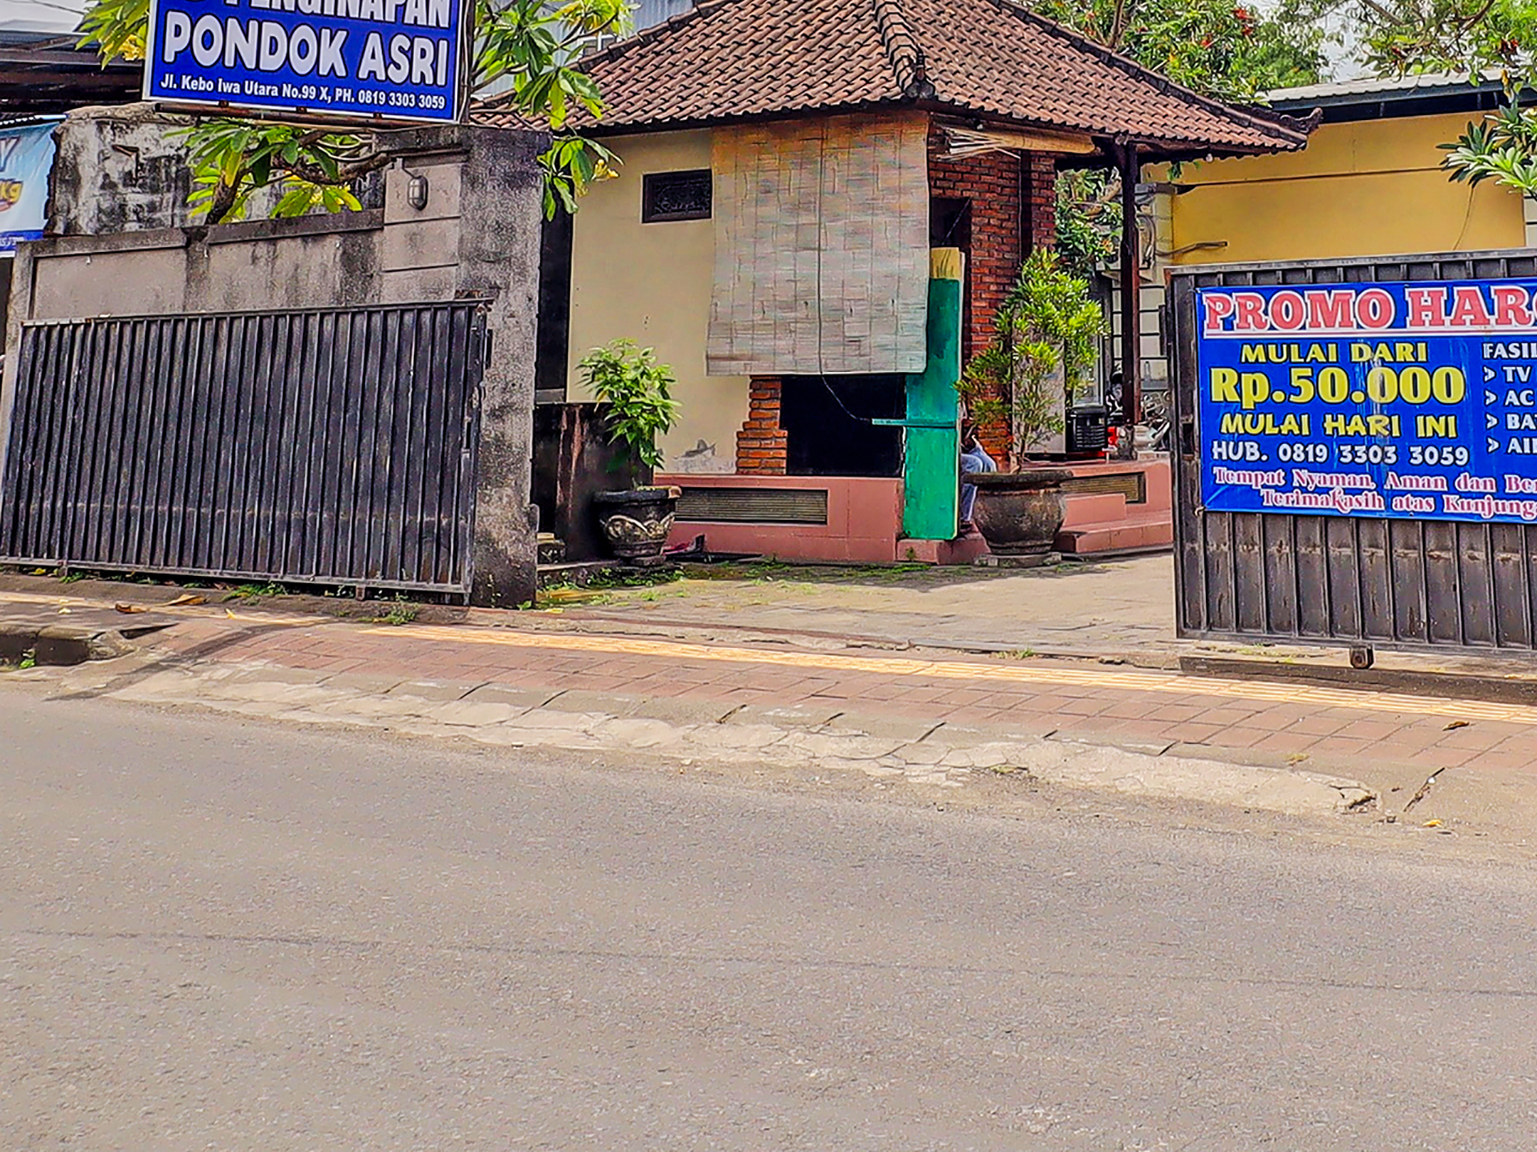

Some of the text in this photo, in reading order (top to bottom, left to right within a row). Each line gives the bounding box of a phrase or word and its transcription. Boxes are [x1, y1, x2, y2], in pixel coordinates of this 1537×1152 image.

[163, 11, 449, 87] PONDOK ASRI
[160, 73, 446, 110] Jl. Kebo Iwa Utara No.99 X, PH. 0819 3303 3059
[1202, 288, 1395, 331] PROMO
[1241, 342, 1428, 363] MULAI DARI
[1502, 365, 1531, 383] TV
[1210, 366, 1465, 411] Rp.50.000
[1504, 389, 1535, 407] AC
[1220, 413, 1457, 439] MULAI HARI INI
[1211, 440, 1470, 466] HUB. 0819 3303 3059
[1213, 467, 1285, 489] Tempat
[1384, 471, 1448, 491] Aman
[1455, 472, 1497, 492] dan
[1260, 487, 1385, 513] Terimakasih
[1392, 493, 1435, 513] atas
